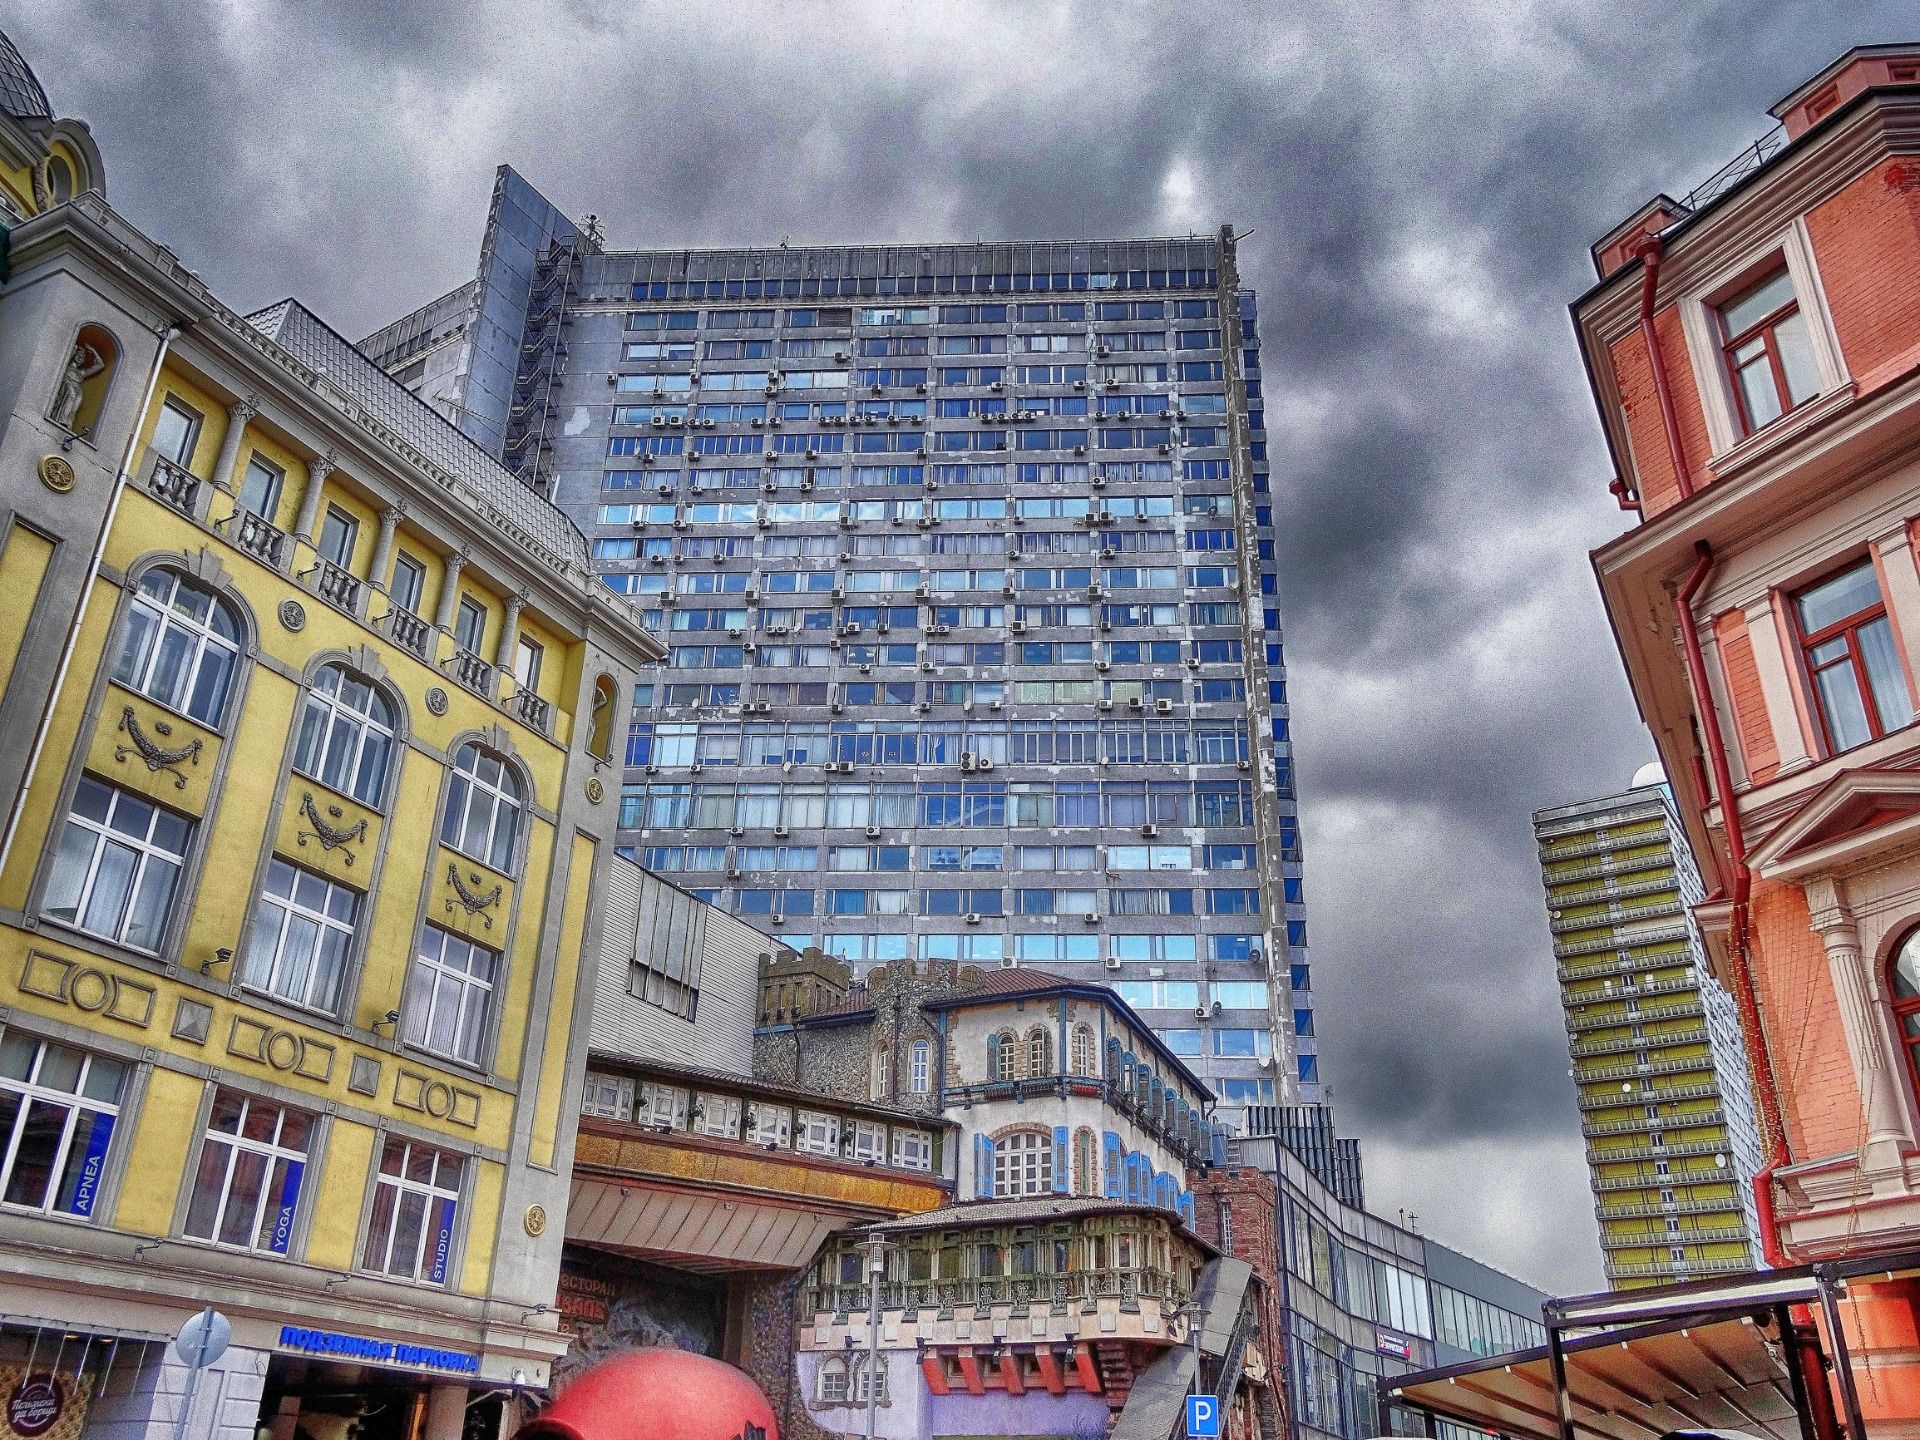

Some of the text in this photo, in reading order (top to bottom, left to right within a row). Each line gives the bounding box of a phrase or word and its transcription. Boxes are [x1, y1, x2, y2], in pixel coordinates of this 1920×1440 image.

[77, 1155, 101, 1212] APNEA
[274, 1206, 293, 1248] YOGA
[433, 1229, 449, 1280] STUDIO
[560, 1273, 616, 1297] ЕСТОРАН
[279, 1325, 481, 1373] ПОДЗЕМНАЯ ПАРКОВКА
[1195, 1400, 1212, 1431] P
